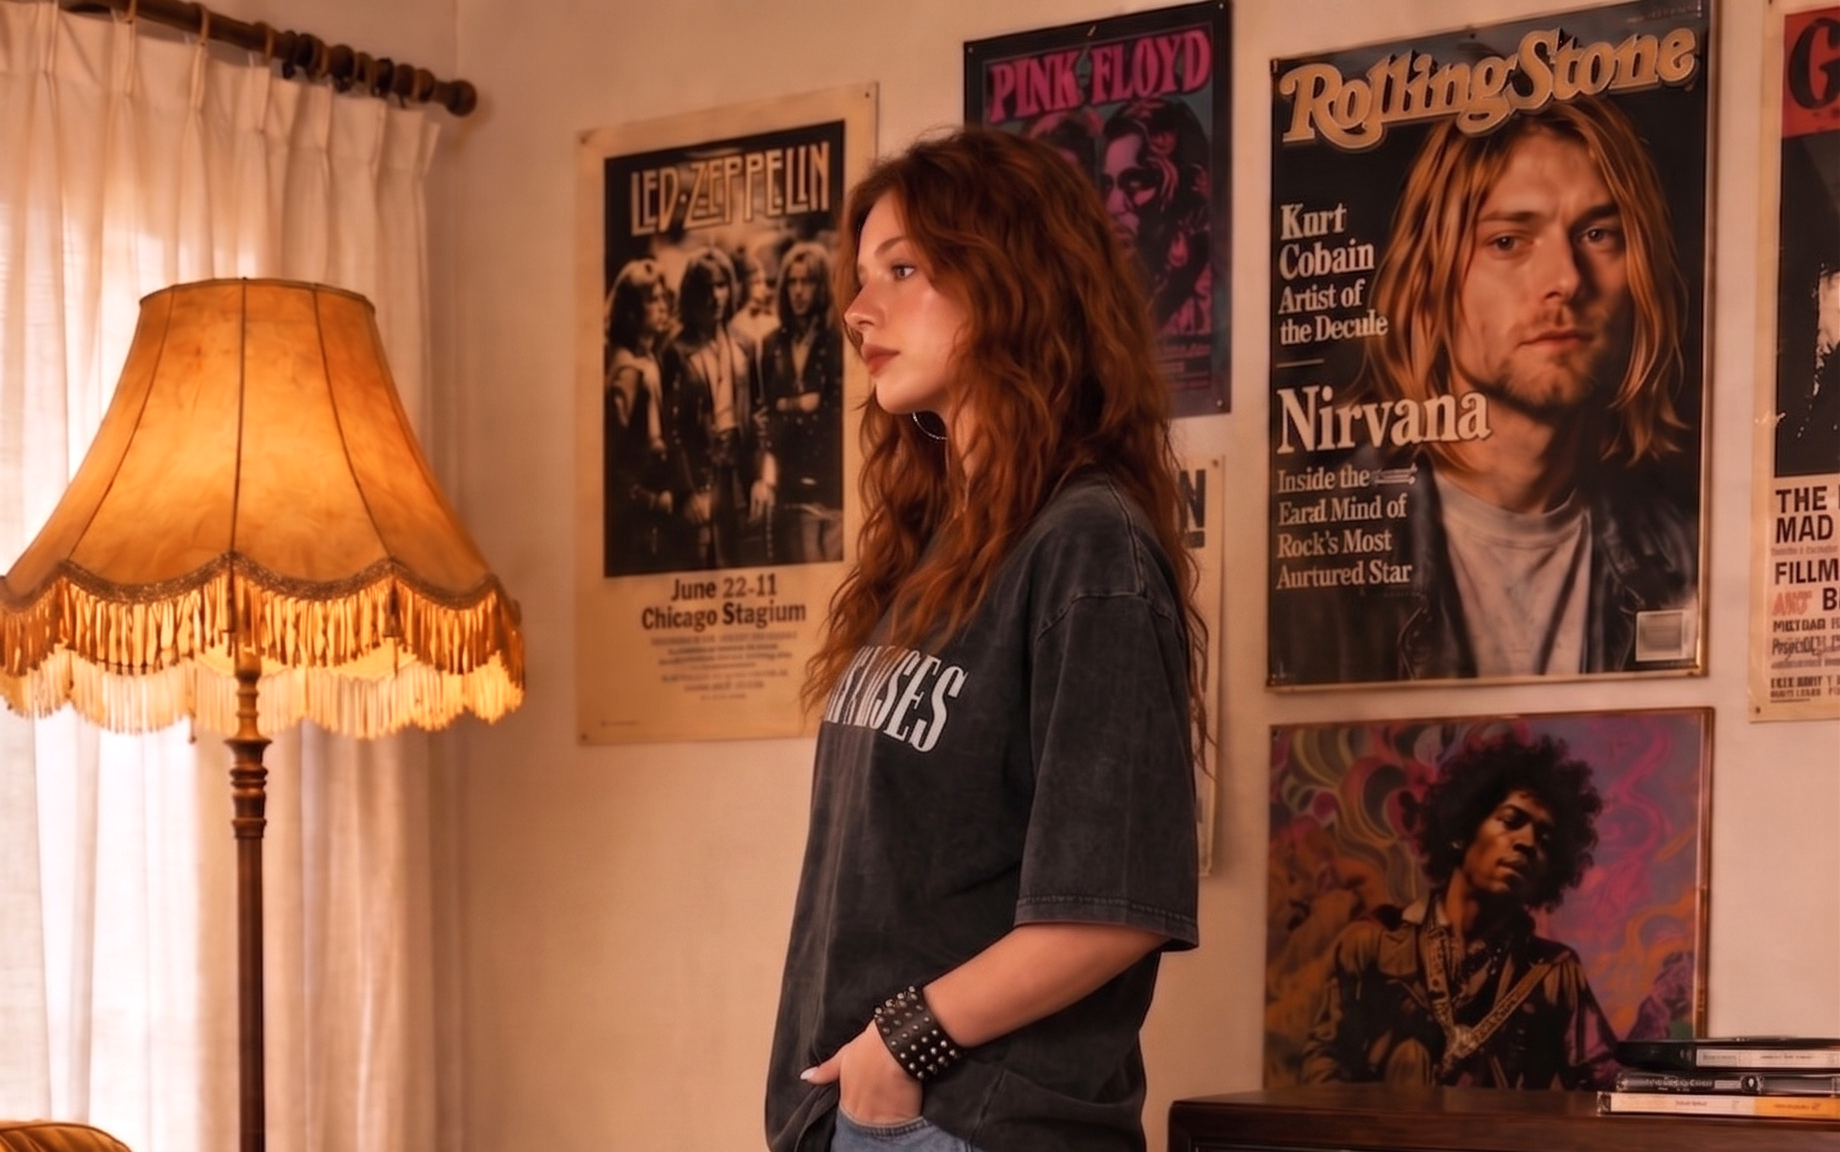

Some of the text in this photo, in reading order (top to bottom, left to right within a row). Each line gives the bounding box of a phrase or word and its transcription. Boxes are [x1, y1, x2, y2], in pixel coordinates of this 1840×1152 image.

[988, 30, 1213, 124] PINK FLOYD
[1279, 27, 1698, 151] Rolling Stone
[1280, 202, 1347, 241] Kurt
[1279, 238, 1375, 281] Cobain
[1278, 278, 1366, 315] Artist of
[1280, 319, 1312, 345] the
[1276, 386, 1492, 455] Nirvana
[1278, 464, 1370, 494] Inside the
[1330, 494, 1382, 521] Mind
[1386, 492, 1408, 518] of
[1775, 486, 1827, 513] THE
[1775, 514, 1834, 543] MAD
[1277, 529, 1392, 558] Rock's Most
[1369, 559, 1413, 584] Star
[1775, 558, 1839, 585] FILLM
[671, 573, 777, 602] June 22-11
[642, 606, 717, 633] Chicago
